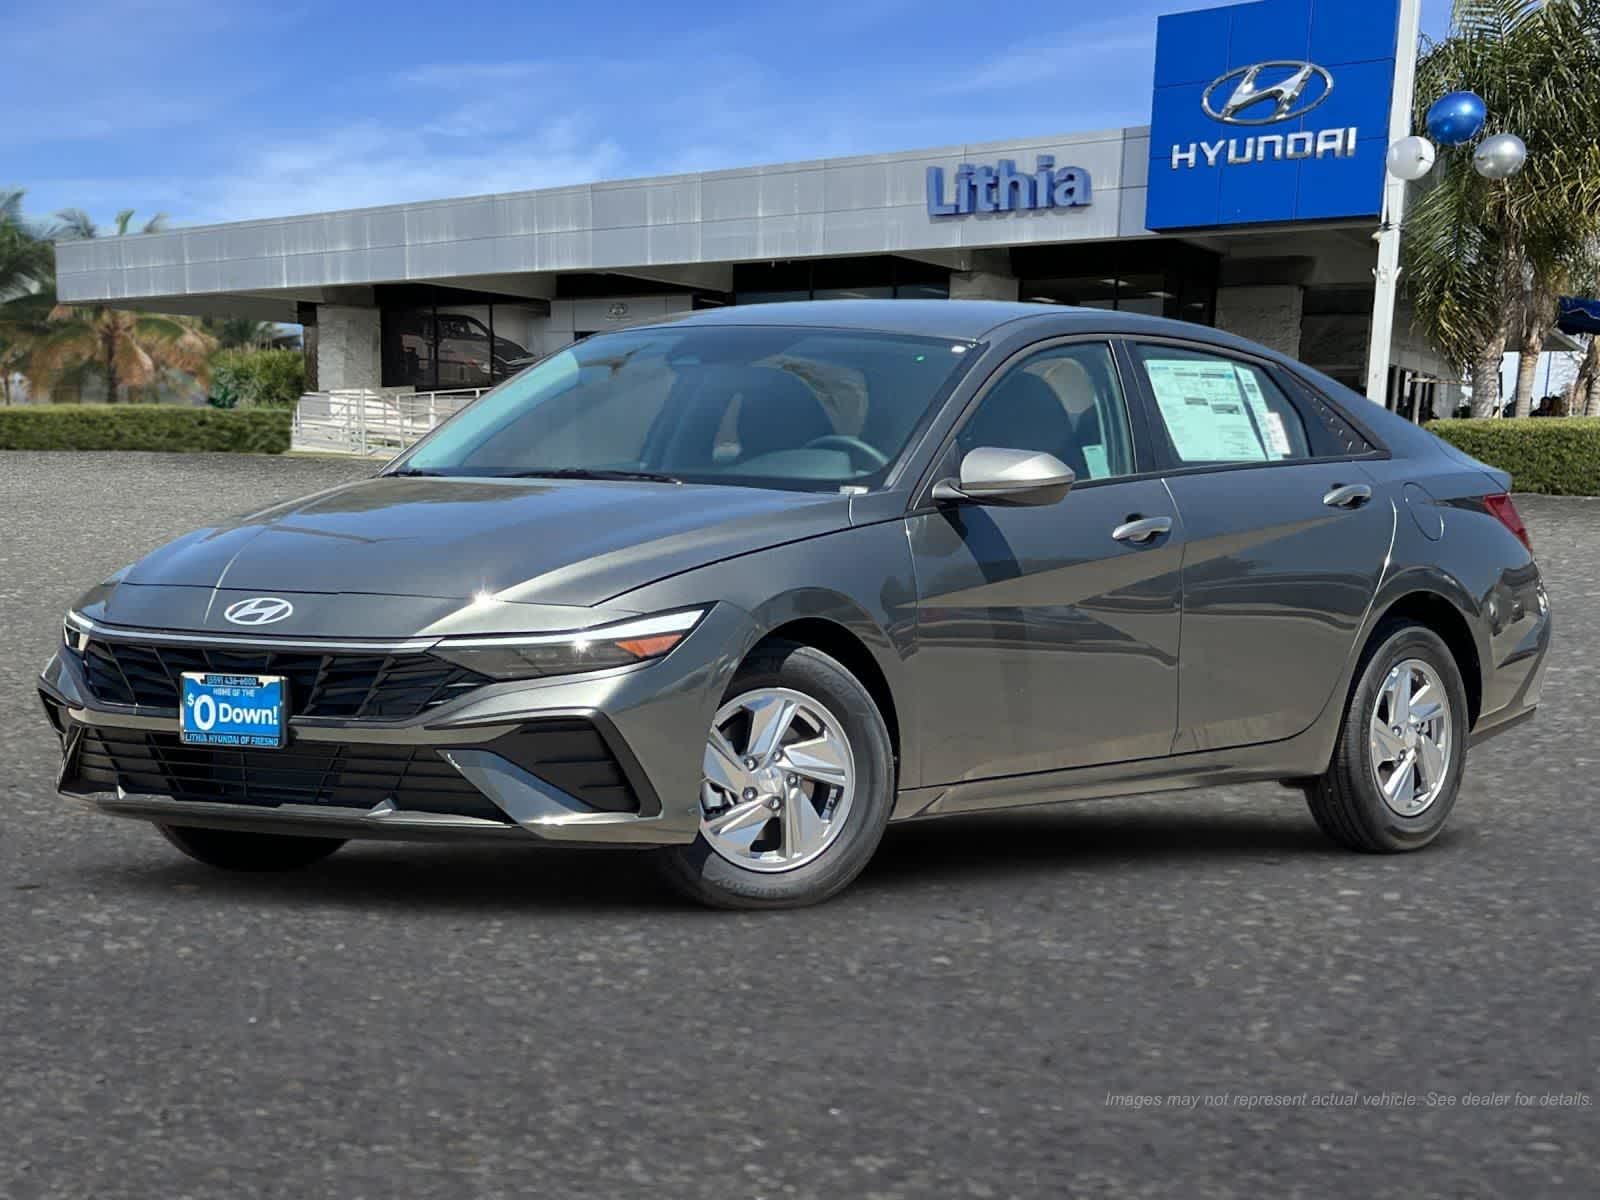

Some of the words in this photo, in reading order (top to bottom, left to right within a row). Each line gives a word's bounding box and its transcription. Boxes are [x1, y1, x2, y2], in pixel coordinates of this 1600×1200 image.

[1171, 127, 1358, 168] HYUNDAI
[926, 155, 1093, 216] Lithia
[213, 687, 231, 696] HOME
[232, 688, 241, 697] OF
[242, 689, 255, 697] THE
[218, 702, 278, 725] Down!
[185, 734, 207, 742] LITHIA
[208, 735, 240, 744] HYUNDAI
[240, 736, 249, 744] OF
[250, 737, 279, 746] FRESNO
